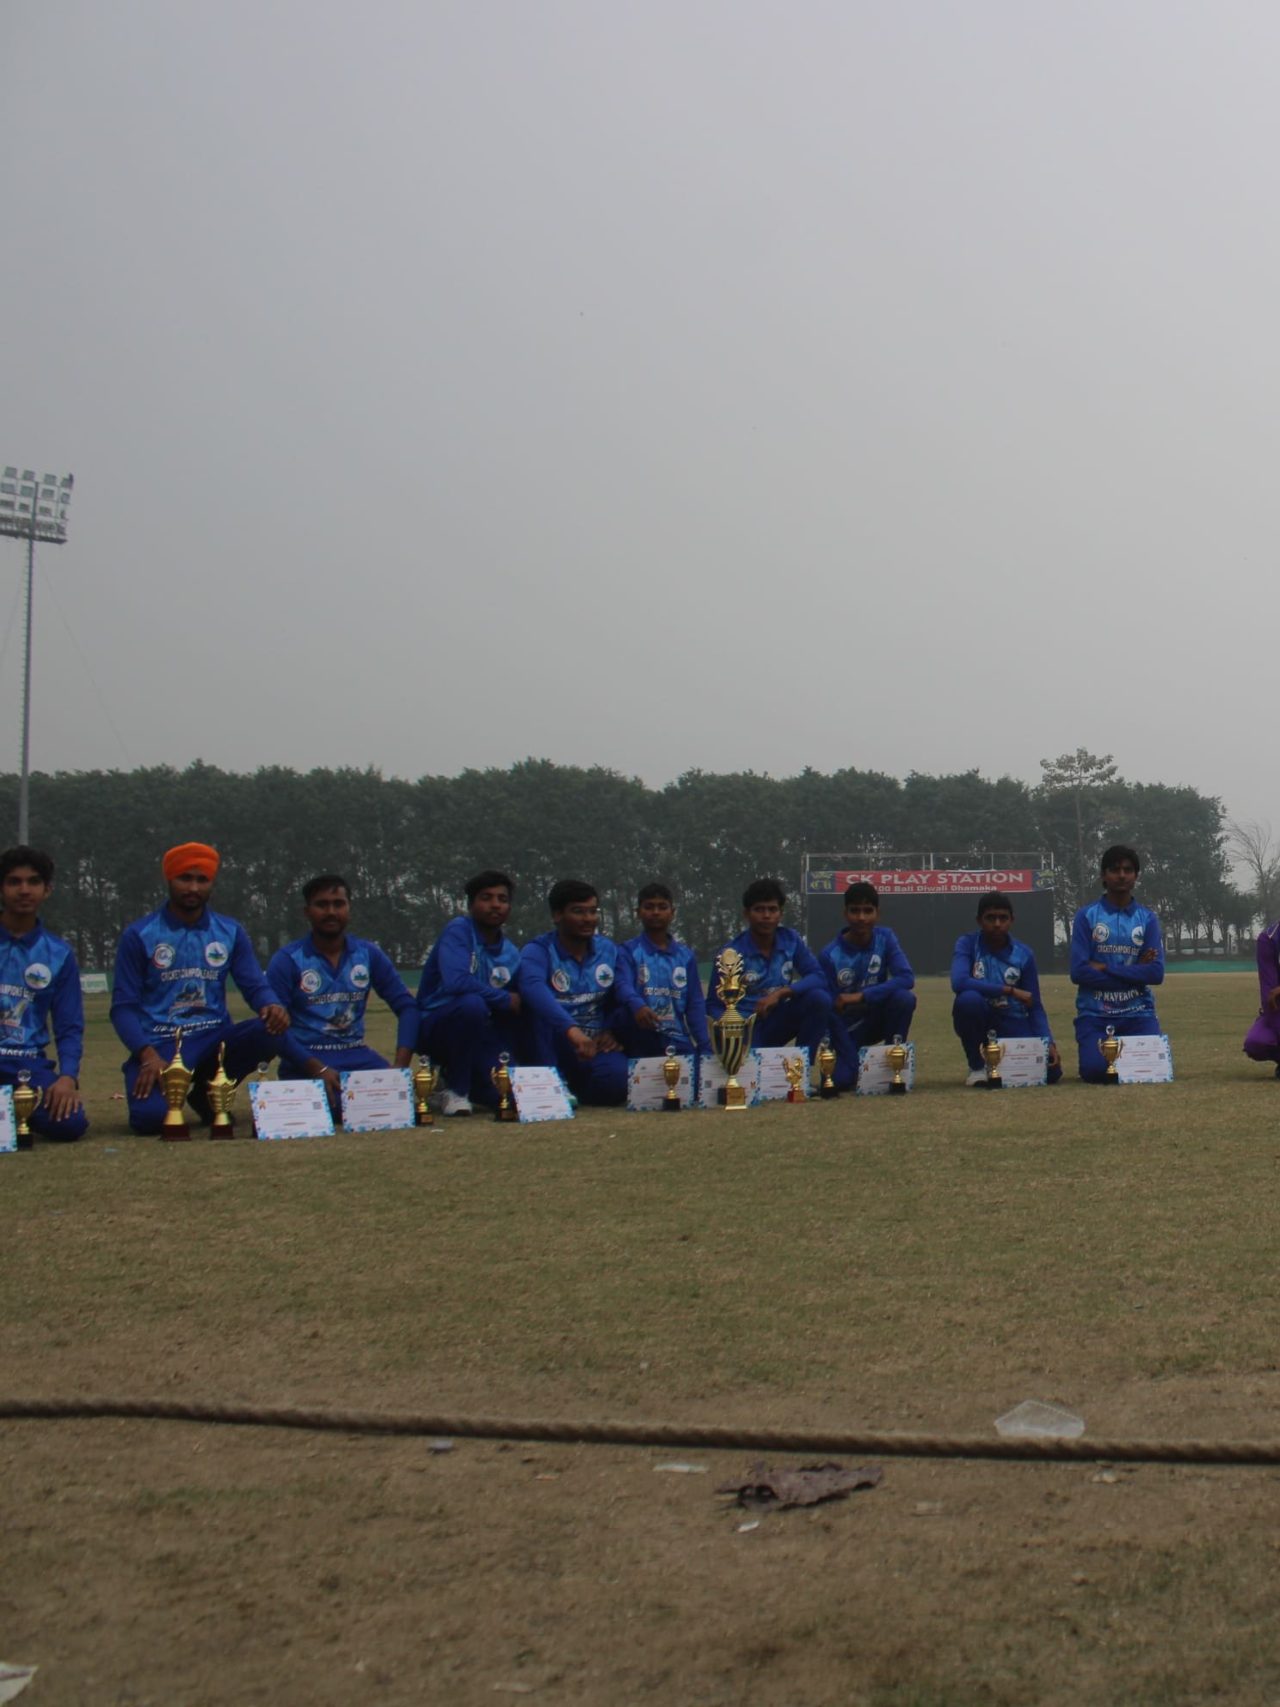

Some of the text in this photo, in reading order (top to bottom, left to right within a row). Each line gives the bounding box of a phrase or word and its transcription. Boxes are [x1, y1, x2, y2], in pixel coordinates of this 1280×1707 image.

[846, 874, 874, 884] CK
[881, 873, 931, 885] PLAY
[937, 872, 1024, 884] STATION
[917, 884, 947, 892] Diwali
[950, 884, 997, 892] Dhamaka
